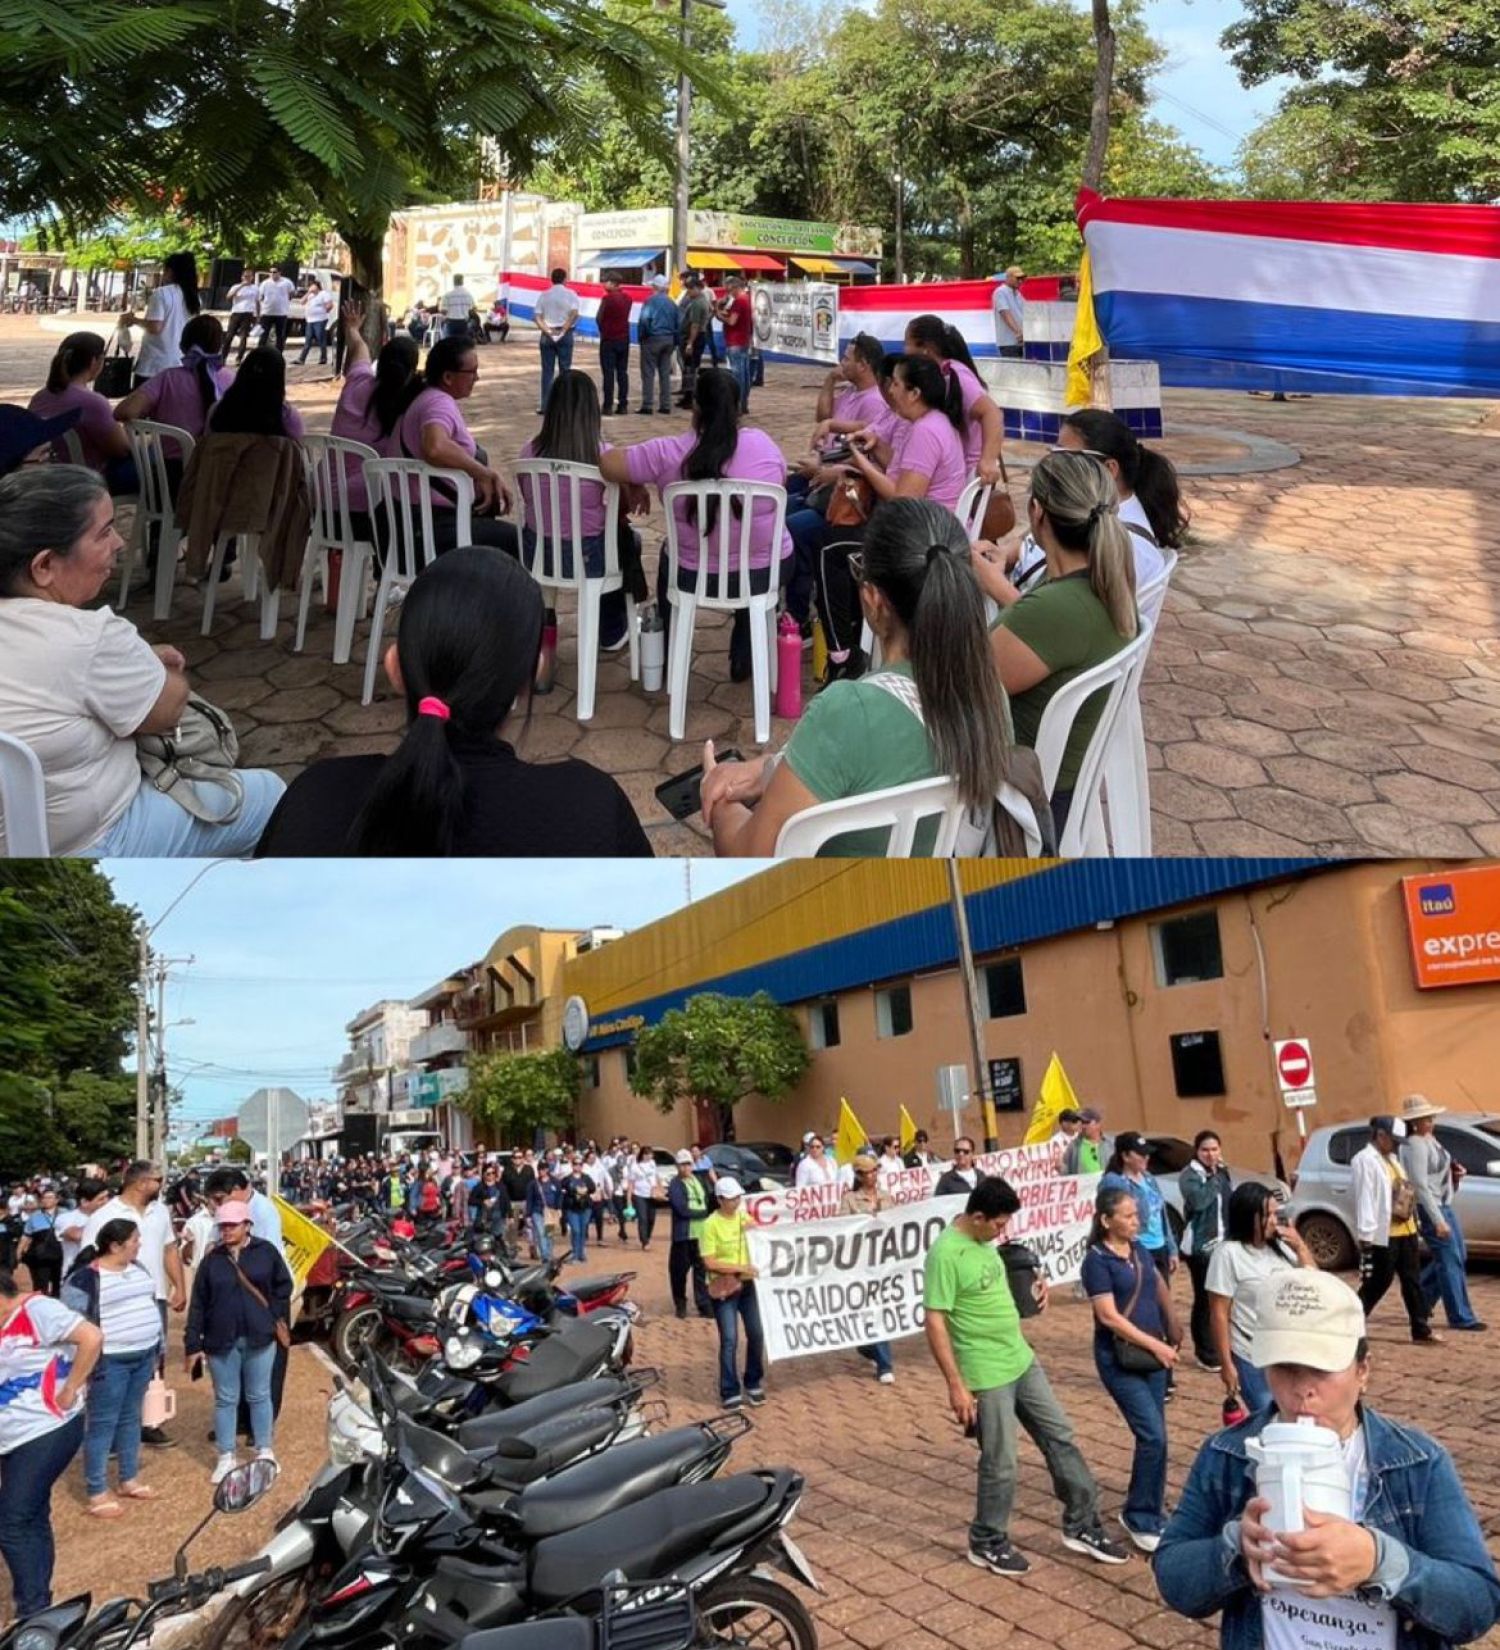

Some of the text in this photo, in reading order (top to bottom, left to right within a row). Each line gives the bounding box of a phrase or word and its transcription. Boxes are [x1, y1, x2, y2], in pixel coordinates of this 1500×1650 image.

[1424, 930, 1500, 958] expre
[982, 1152, 1012, 1171] RO
[1017, 1181, 1078, 1207] RBIETA
[746, 1196, 779, 1226] C
[1010, 1200, 1094, 1236] LLANUEVA
[772, 1273, 905, 1319] TRAIDORES
[783, 1310, 879, 1351] DOCENTE
[882, 1304, 910, 1333] DE
